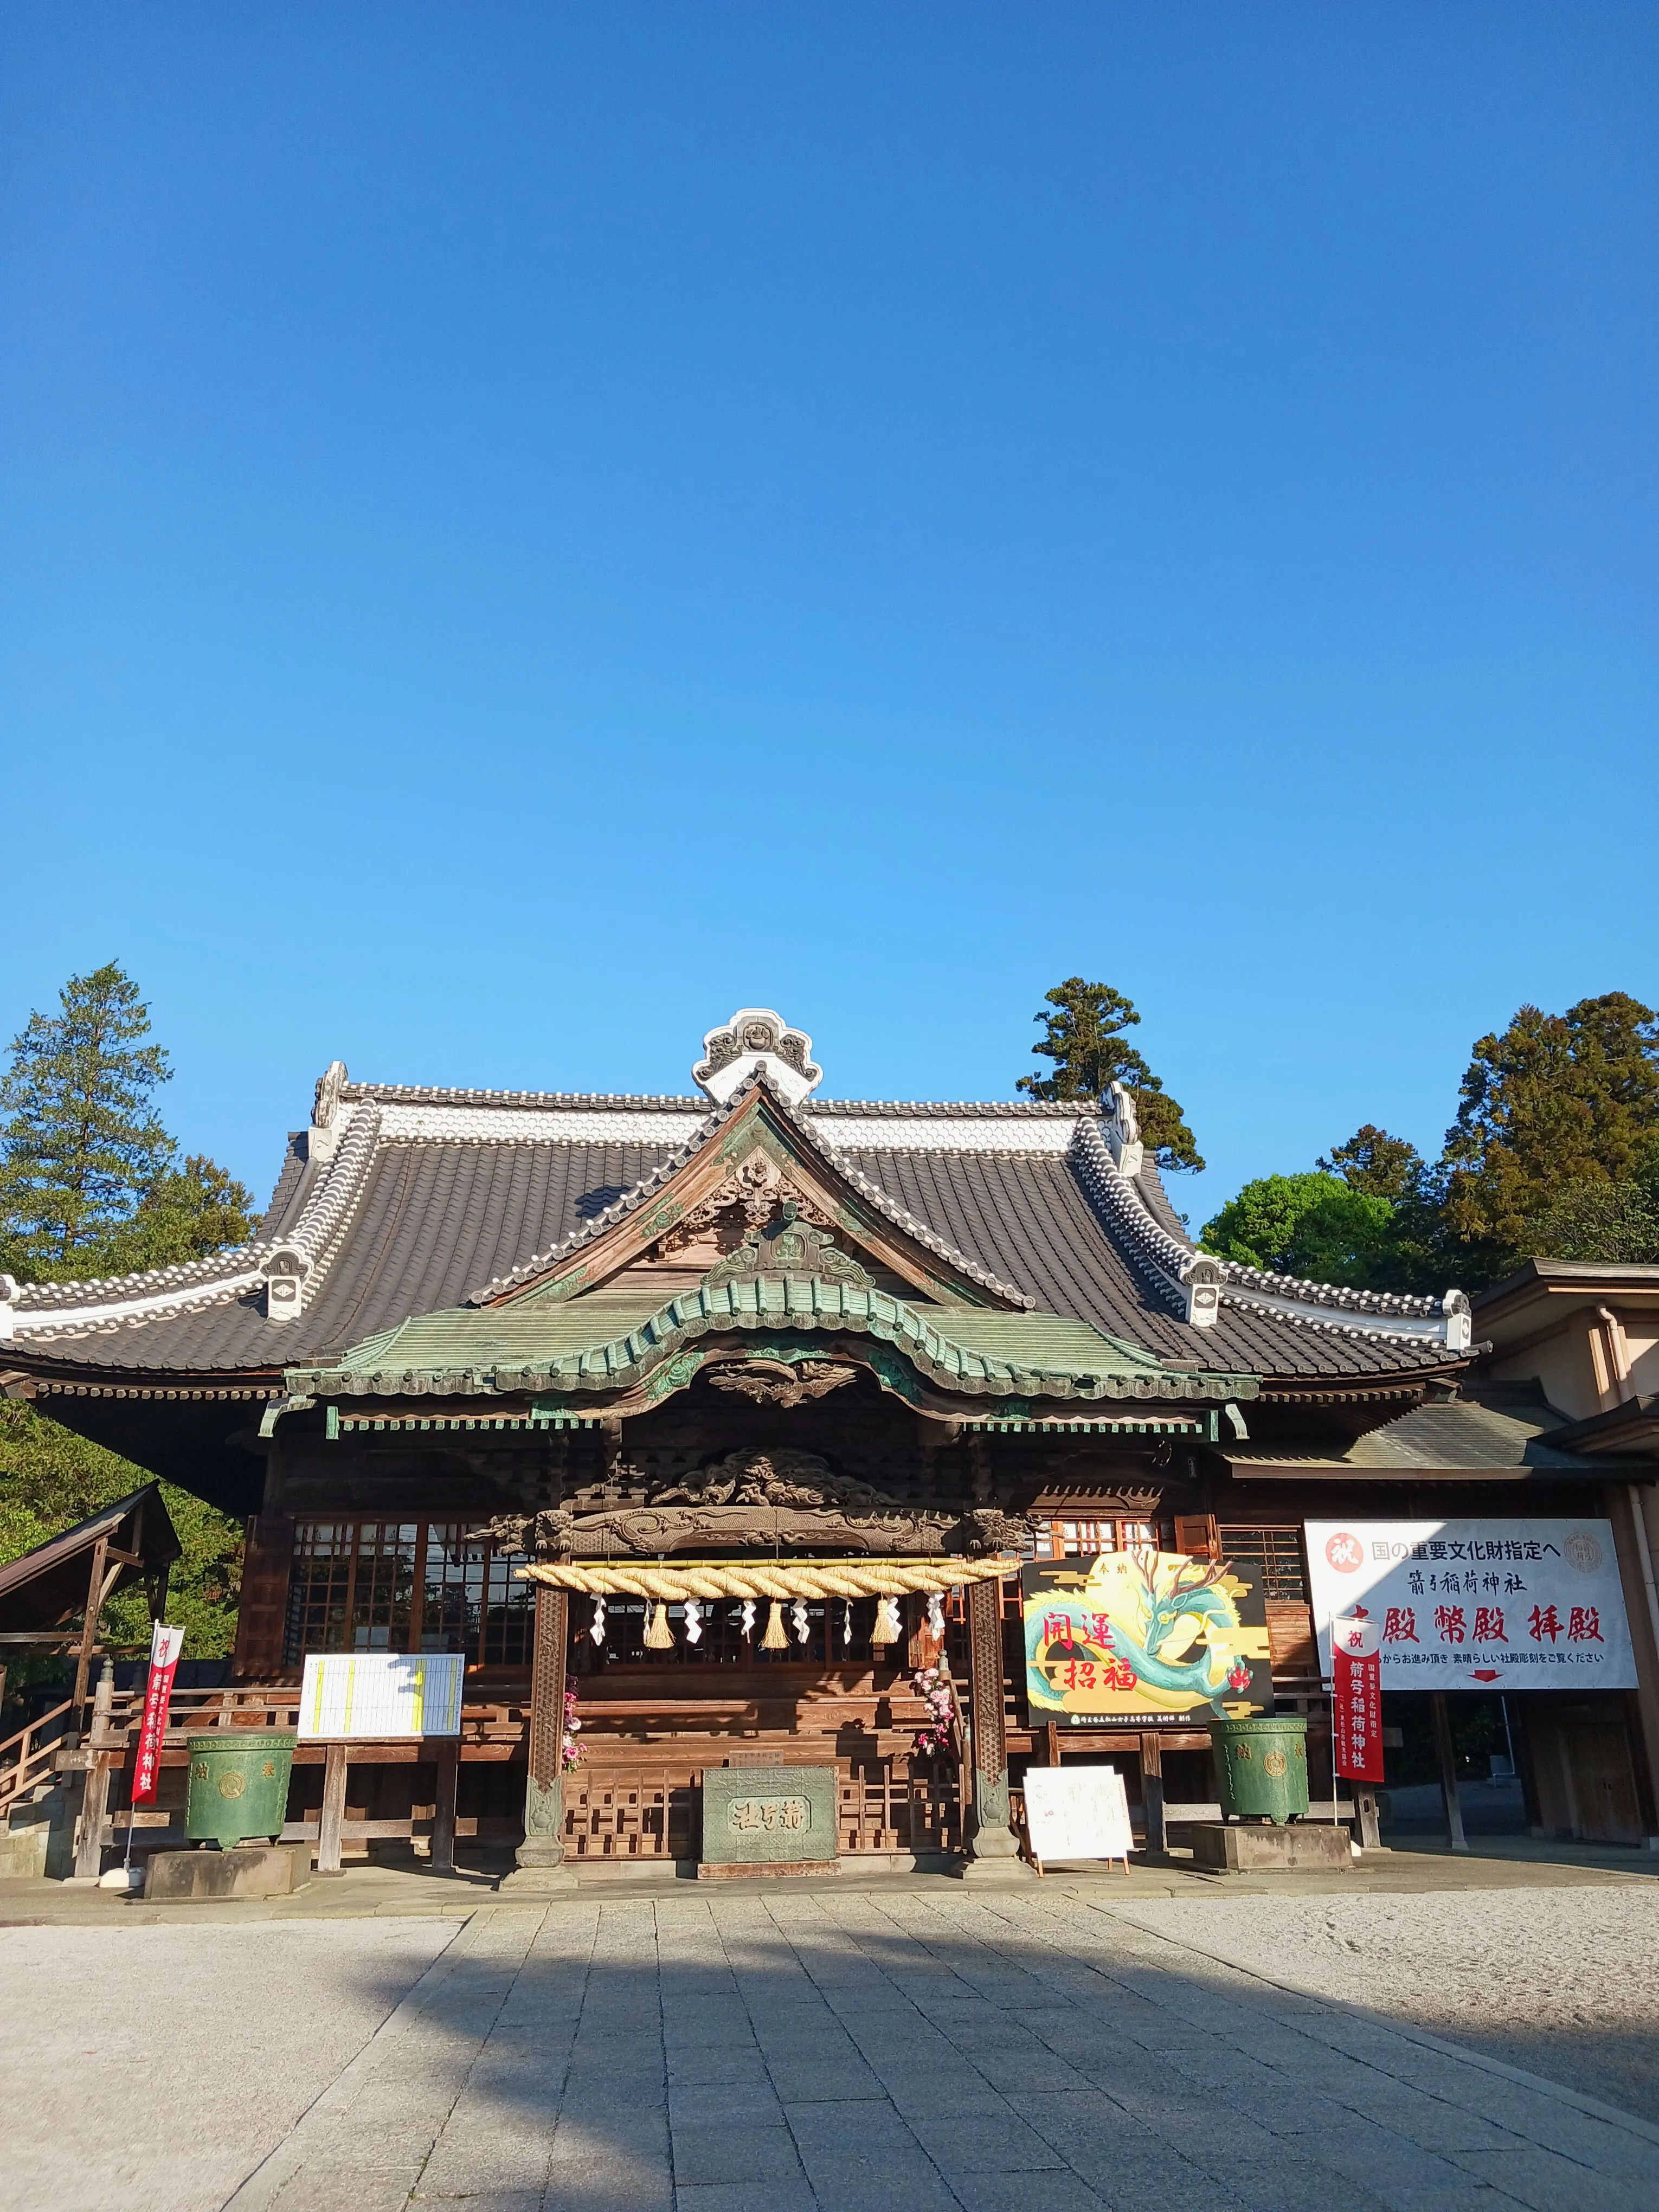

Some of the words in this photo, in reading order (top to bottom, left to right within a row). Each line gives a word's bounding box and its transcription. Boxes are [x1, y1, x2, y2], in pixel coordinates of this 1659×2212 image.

[1330, 1538, 1360, 1566] 祝
[1372, 1540, 1562, 1562] 国の重要文化財指定へ
[1407, 1569, 1528, 1597] 箭弓稲荷神社
[1043, 1611, 1116, 1651] 開運
[1433, 1604, 1509, 1645] 幣殿
[1527, 1603, 1605, 1644] 拝殿
[158, 1638, 170, 1658] 祝
[1348, 1630, 1364, 1649] 祝
[1452, 1652, 1604, 1664] 素晴らしい社殿彫刻をご覧ください
[1063, 1657, 1138, 1692] 招福
[1350, 1661, 1366, 1769] 箭弓稲荷神社
